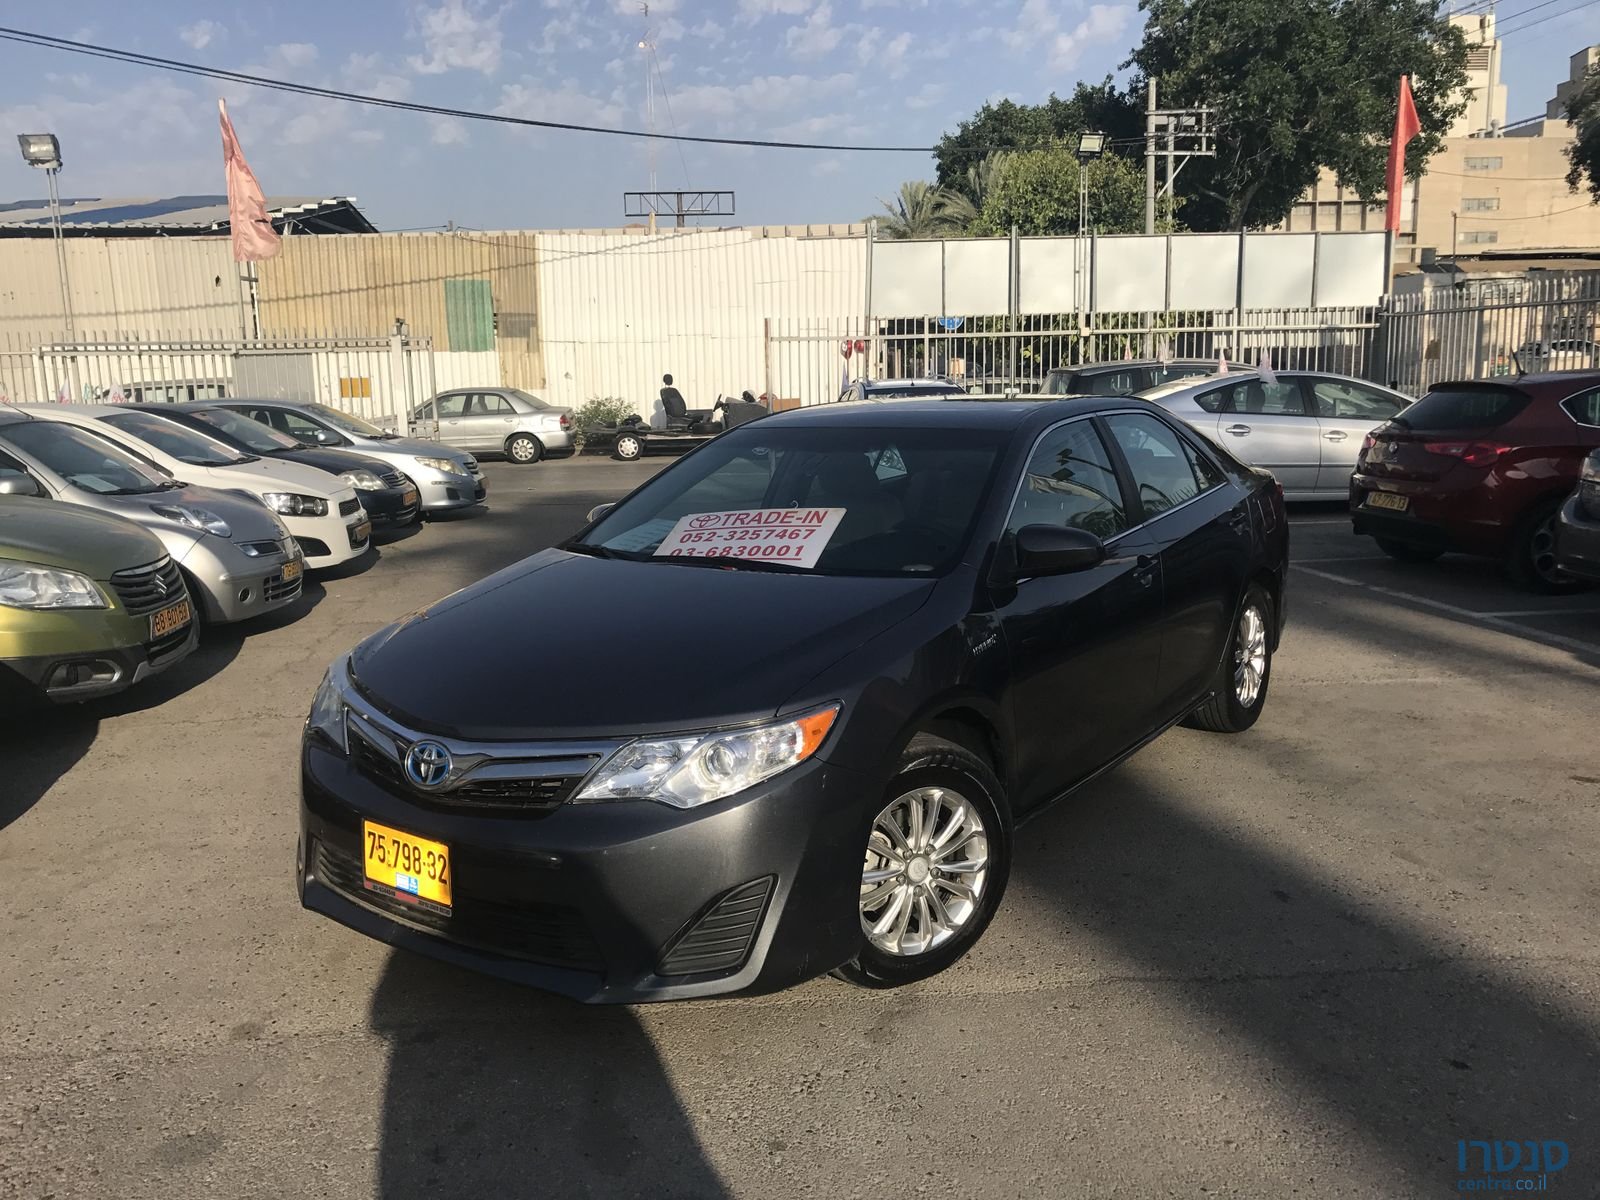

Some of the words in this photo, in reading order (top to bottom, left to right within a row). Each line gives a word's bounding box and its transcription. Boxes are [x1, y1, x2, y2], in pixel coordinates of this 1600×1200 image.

[720, 510, 828, 527] TRADE-IN
[679, 528, 817, 544] 052-3257467
[670, 544, 805, 557] 03-6830001
